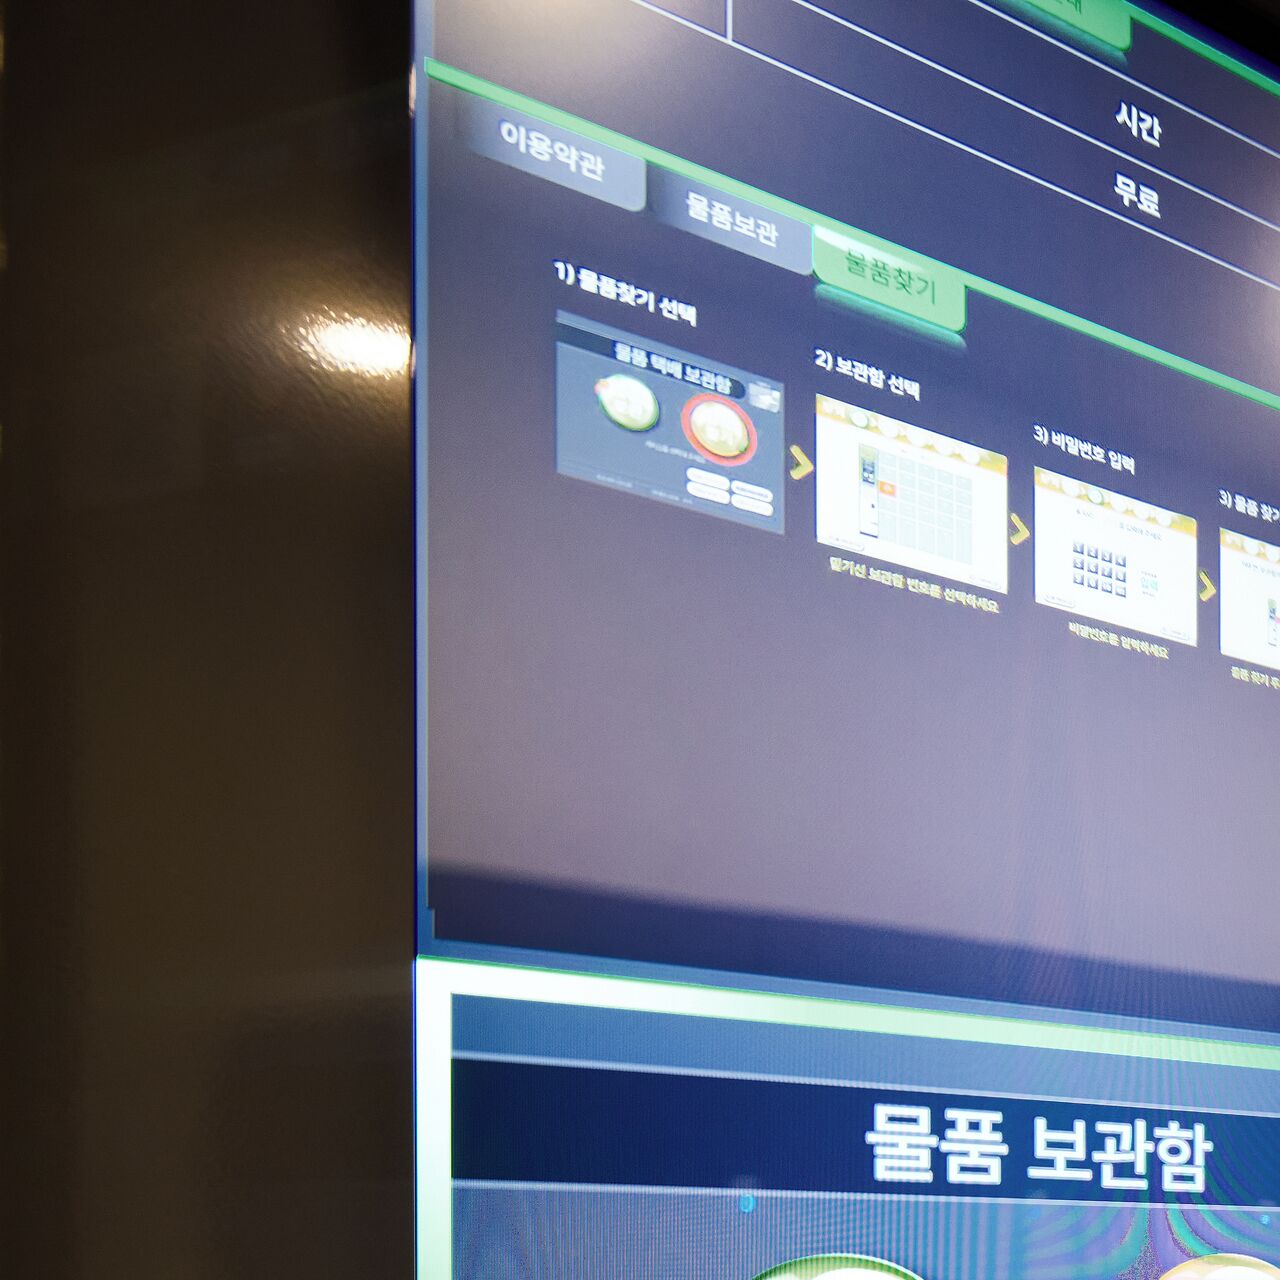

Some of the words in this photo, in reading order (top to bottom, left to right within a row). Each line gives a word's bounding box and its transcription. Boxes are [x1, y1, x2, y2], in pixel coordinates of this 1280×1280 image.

[500, 118, 605, 183] 이용약관
[1115, 100, 1162, 148] 시간
[687, 191, 779, 249] 물품보관
[1113, 172, 1161, 219] 무료
[553, 260, 575, 286] 1)
[578, 267, 655, 313] 물품찾기
[658, 297, 697, 328] 선택
[844, 248, 936, 306] 물품찾기
[814, 349, 833, 371] 2)
[836, 357, 885, 389] 보관함
[888, 373, 920, 401] 선택
[1033, 424, 1048, 446] 3)
[1051, 431, 1106, 464] 비밀번호
[1108, 450, 1135, 476] 입력
[865, 1102, 1010, 1186] 물품
[1026, 1116, 1214, 1193] 보관함
